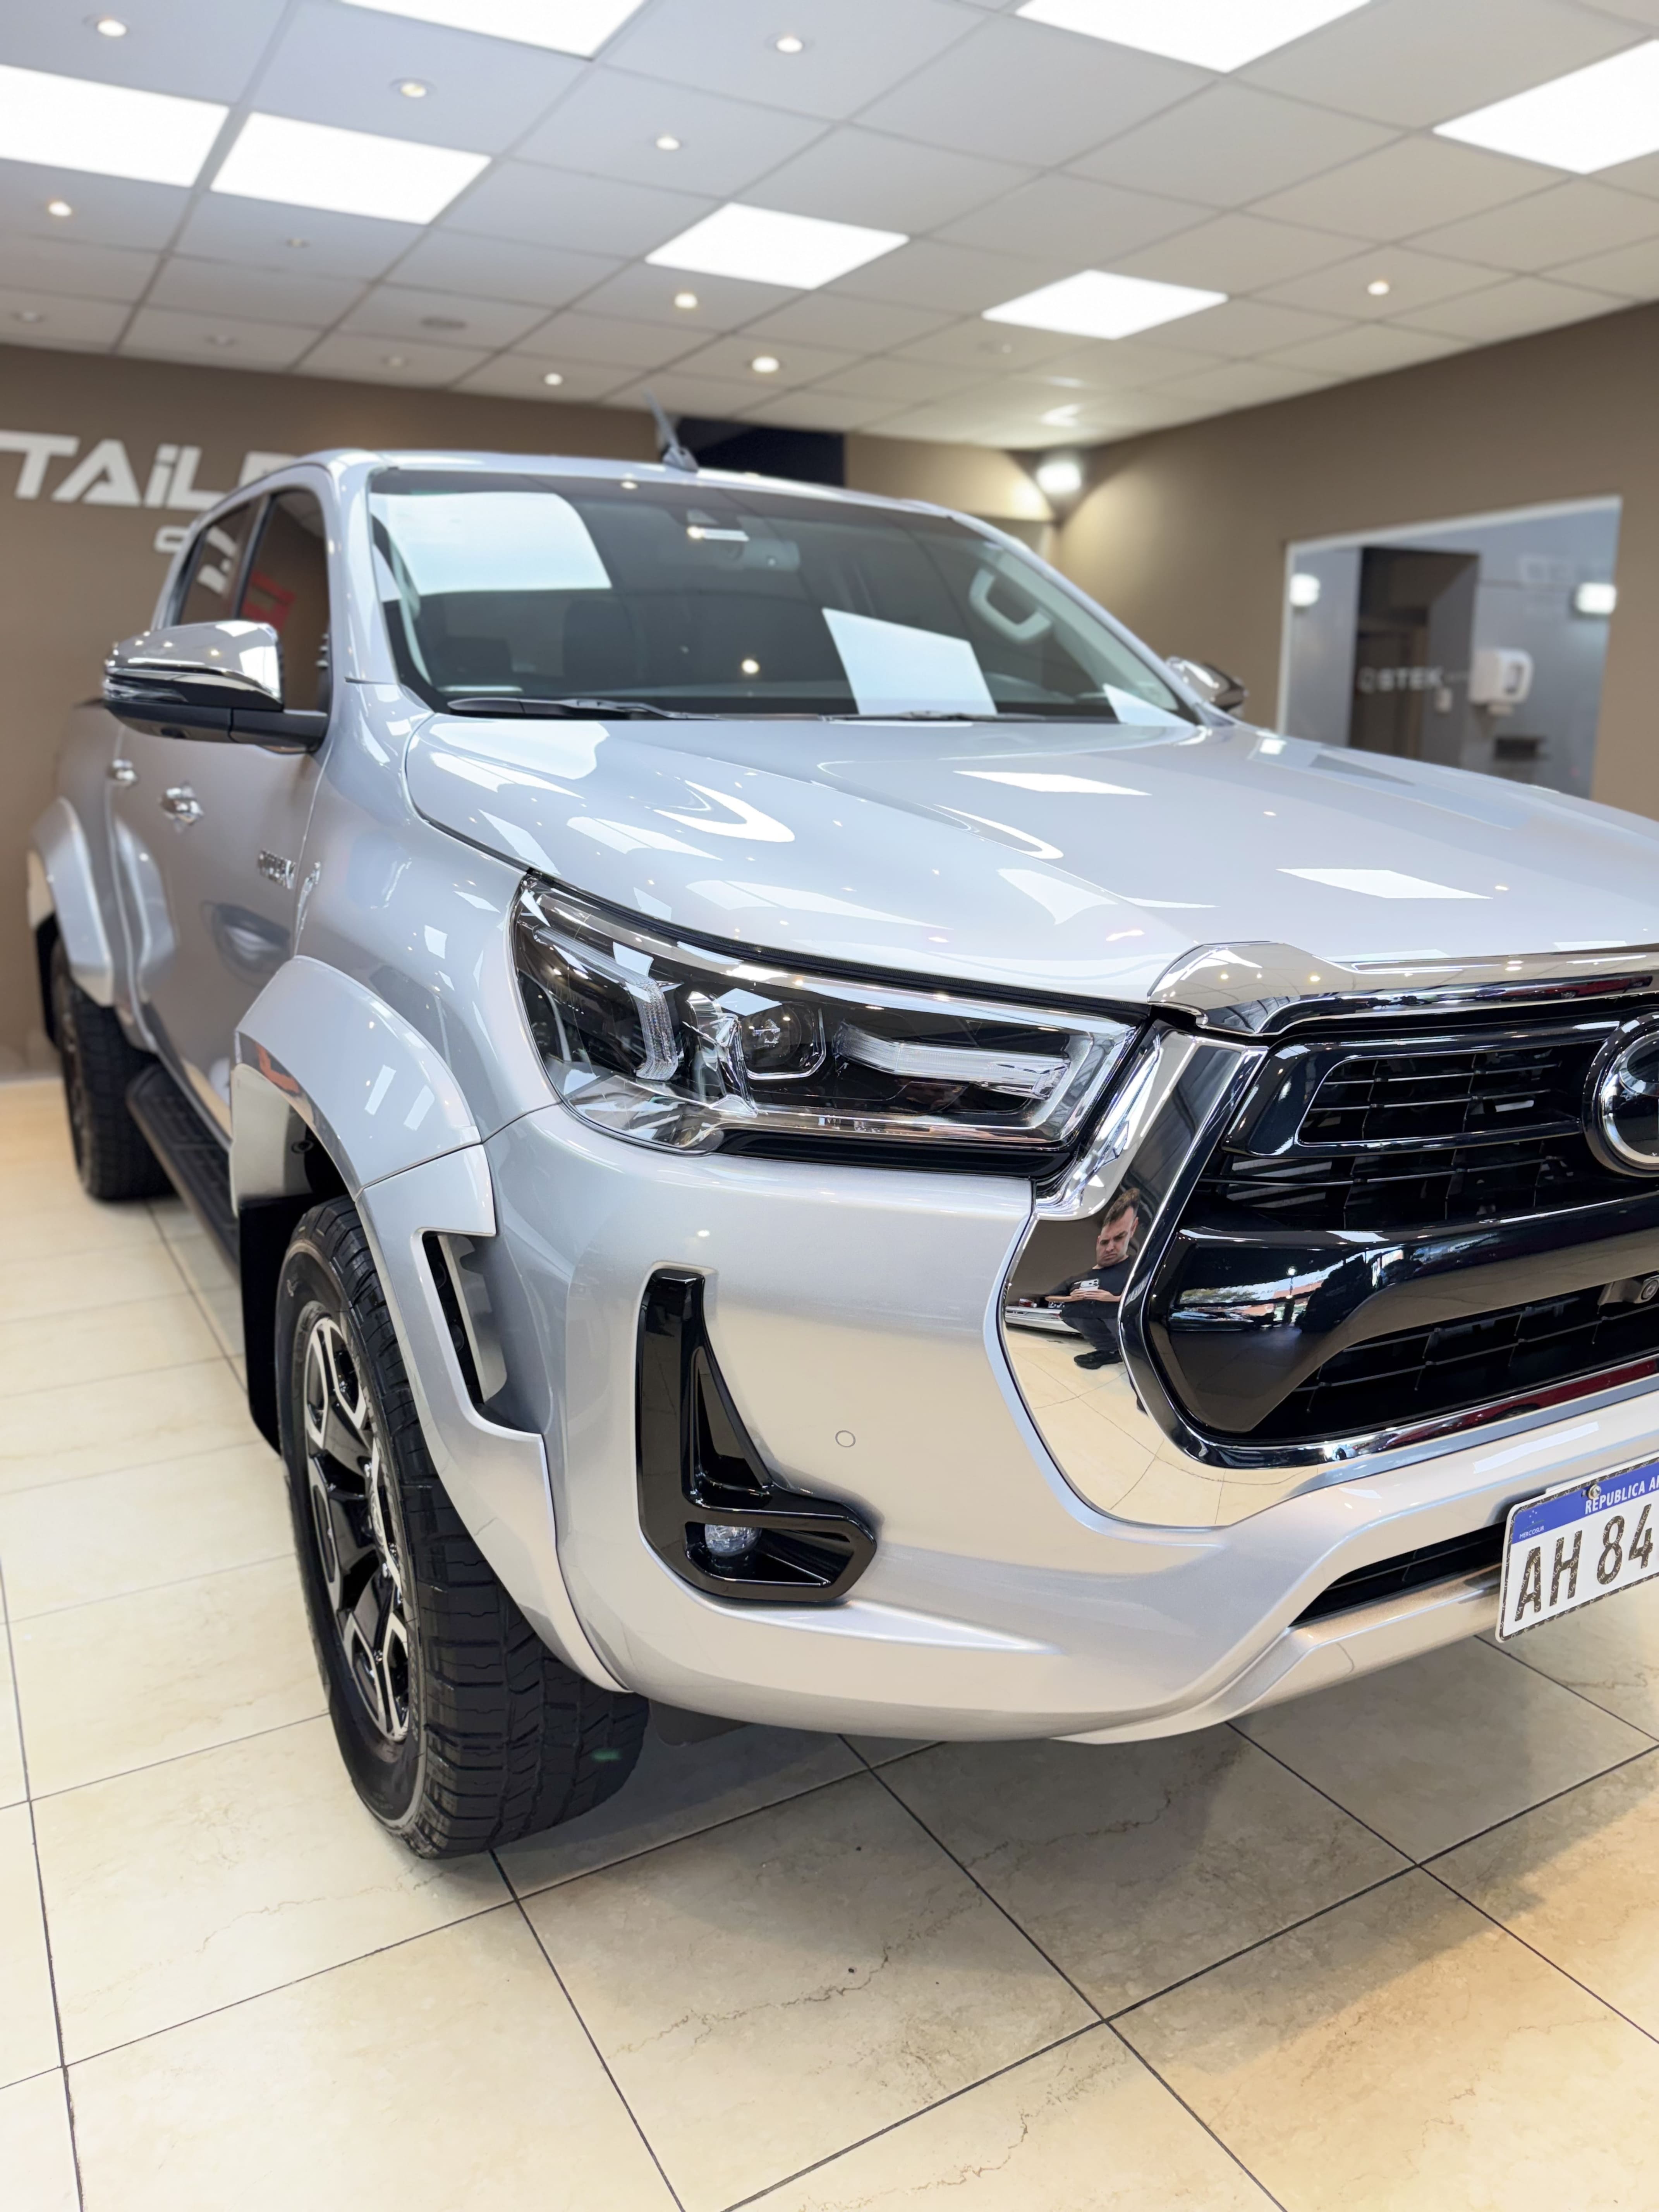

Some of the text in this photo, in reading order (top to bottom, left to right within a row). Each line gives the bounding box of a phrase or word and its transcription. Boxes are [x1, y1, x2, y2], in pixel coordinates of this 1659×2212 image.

[1515, 1530, 1583, 1622] AH
[1597, 1504, 1654, 1585] 84
[1519, 1525, 1544, 1539] MERCOSUR
